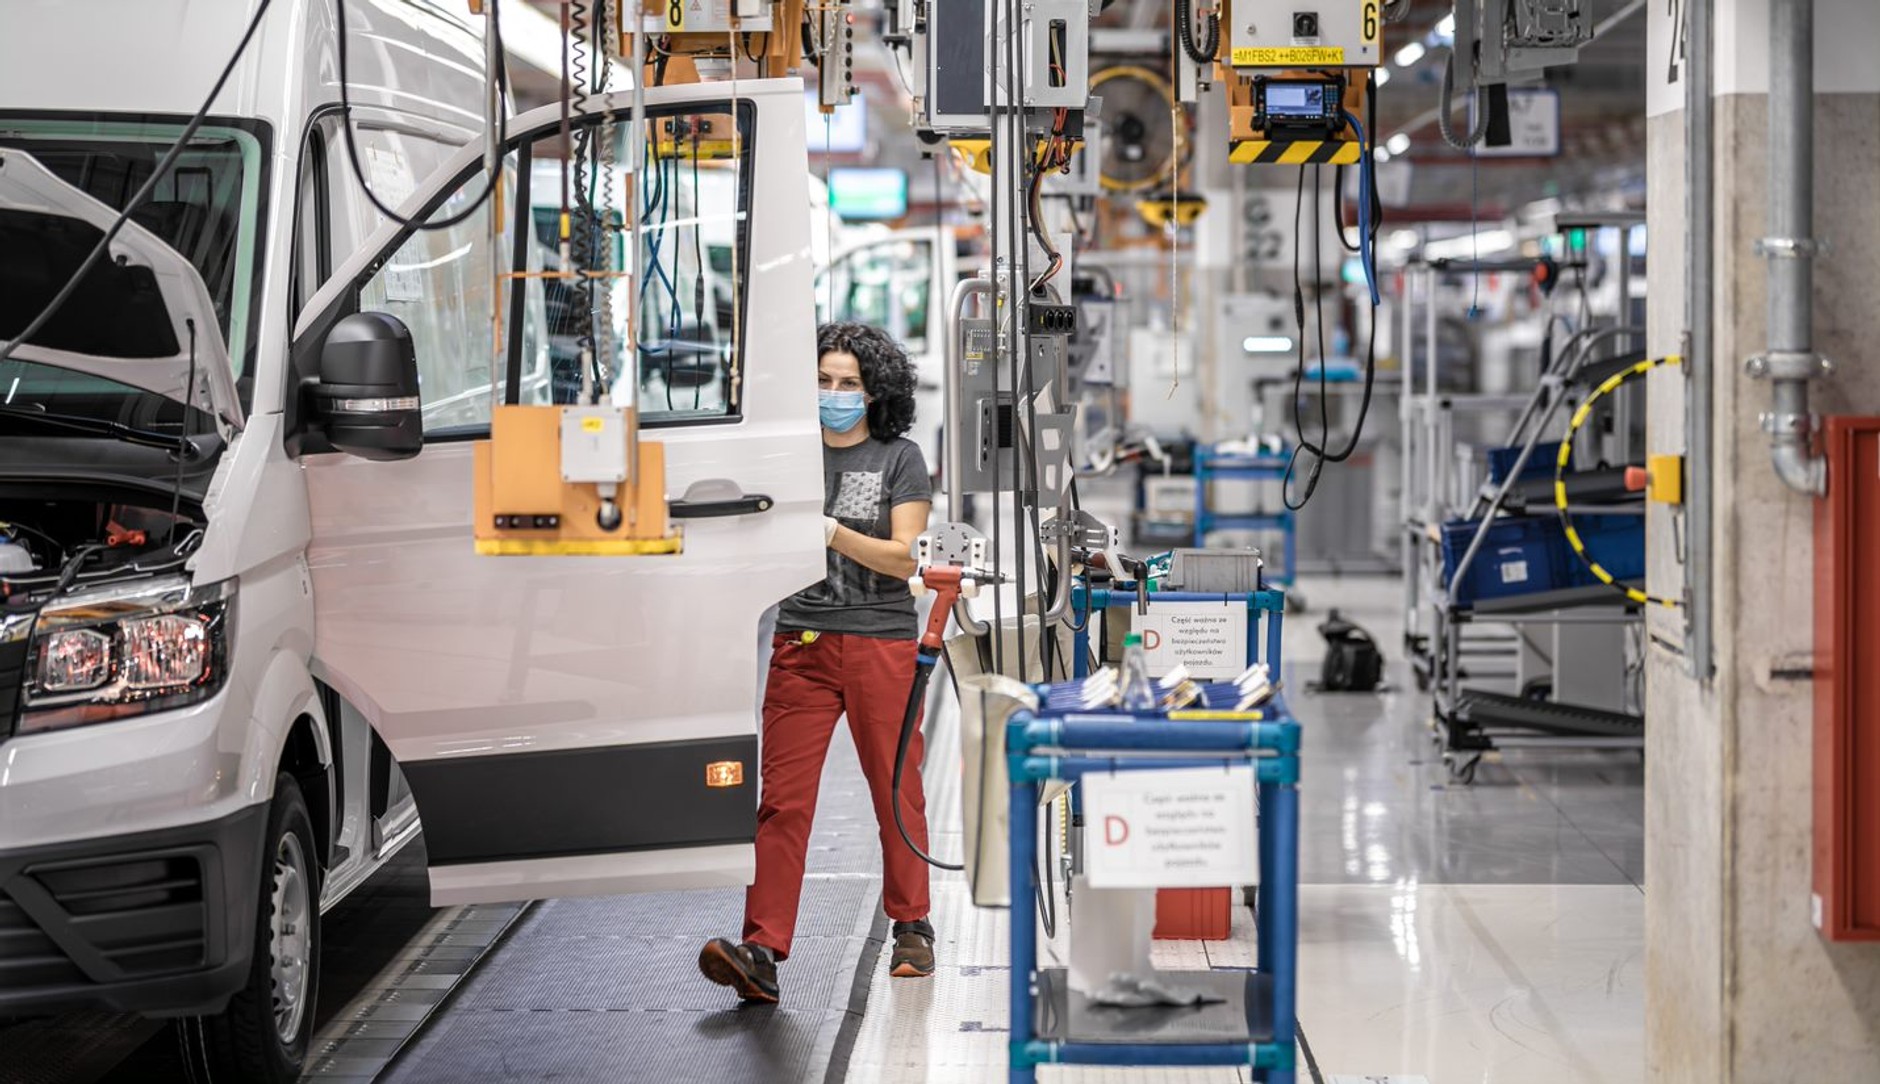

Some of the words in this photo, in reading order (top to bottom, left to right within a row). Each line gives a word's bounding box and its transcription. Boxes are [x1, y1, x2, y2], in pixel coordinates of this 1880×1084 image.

[669, 0, 682, 27] 8
[1363, 2, 1376, 41] 6
[1171, 616, 1192, 625] Część
[1143, 629, 1161, 650] D
[1105, 815, 1129, 846] D
